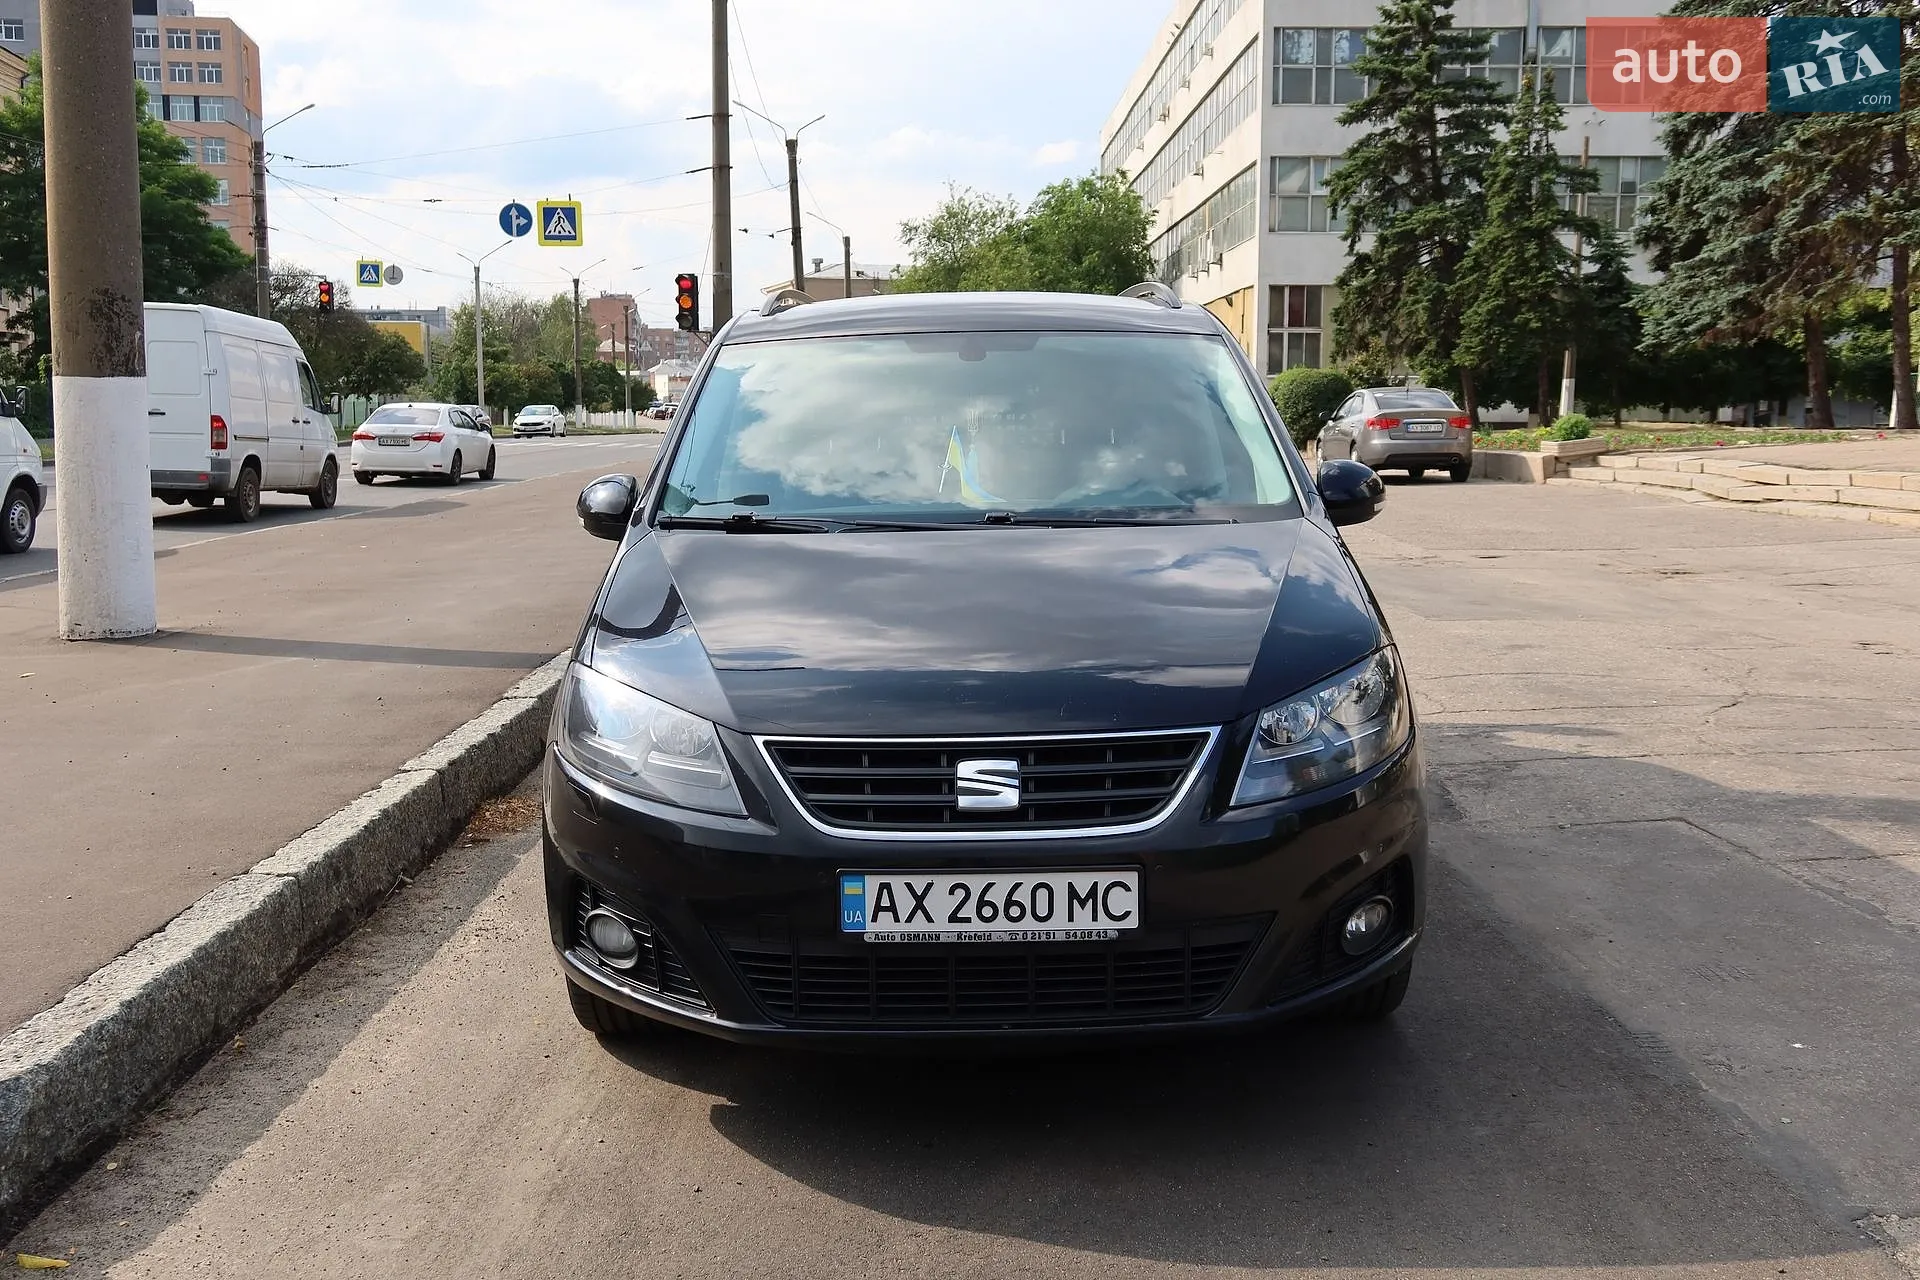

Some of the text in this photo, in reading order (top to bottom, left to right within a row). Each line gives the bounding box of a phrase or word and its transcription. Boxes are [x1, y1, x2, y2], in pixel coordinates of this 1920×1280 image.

[870, 880, 1133, 924] AX 2660 MC
[844, 910, 864, 923] UA
[873, 933, 896, 942] Auto
[900, 933, 941, 942] OSMANN
[956, 932, 992, 941] Krefeld
